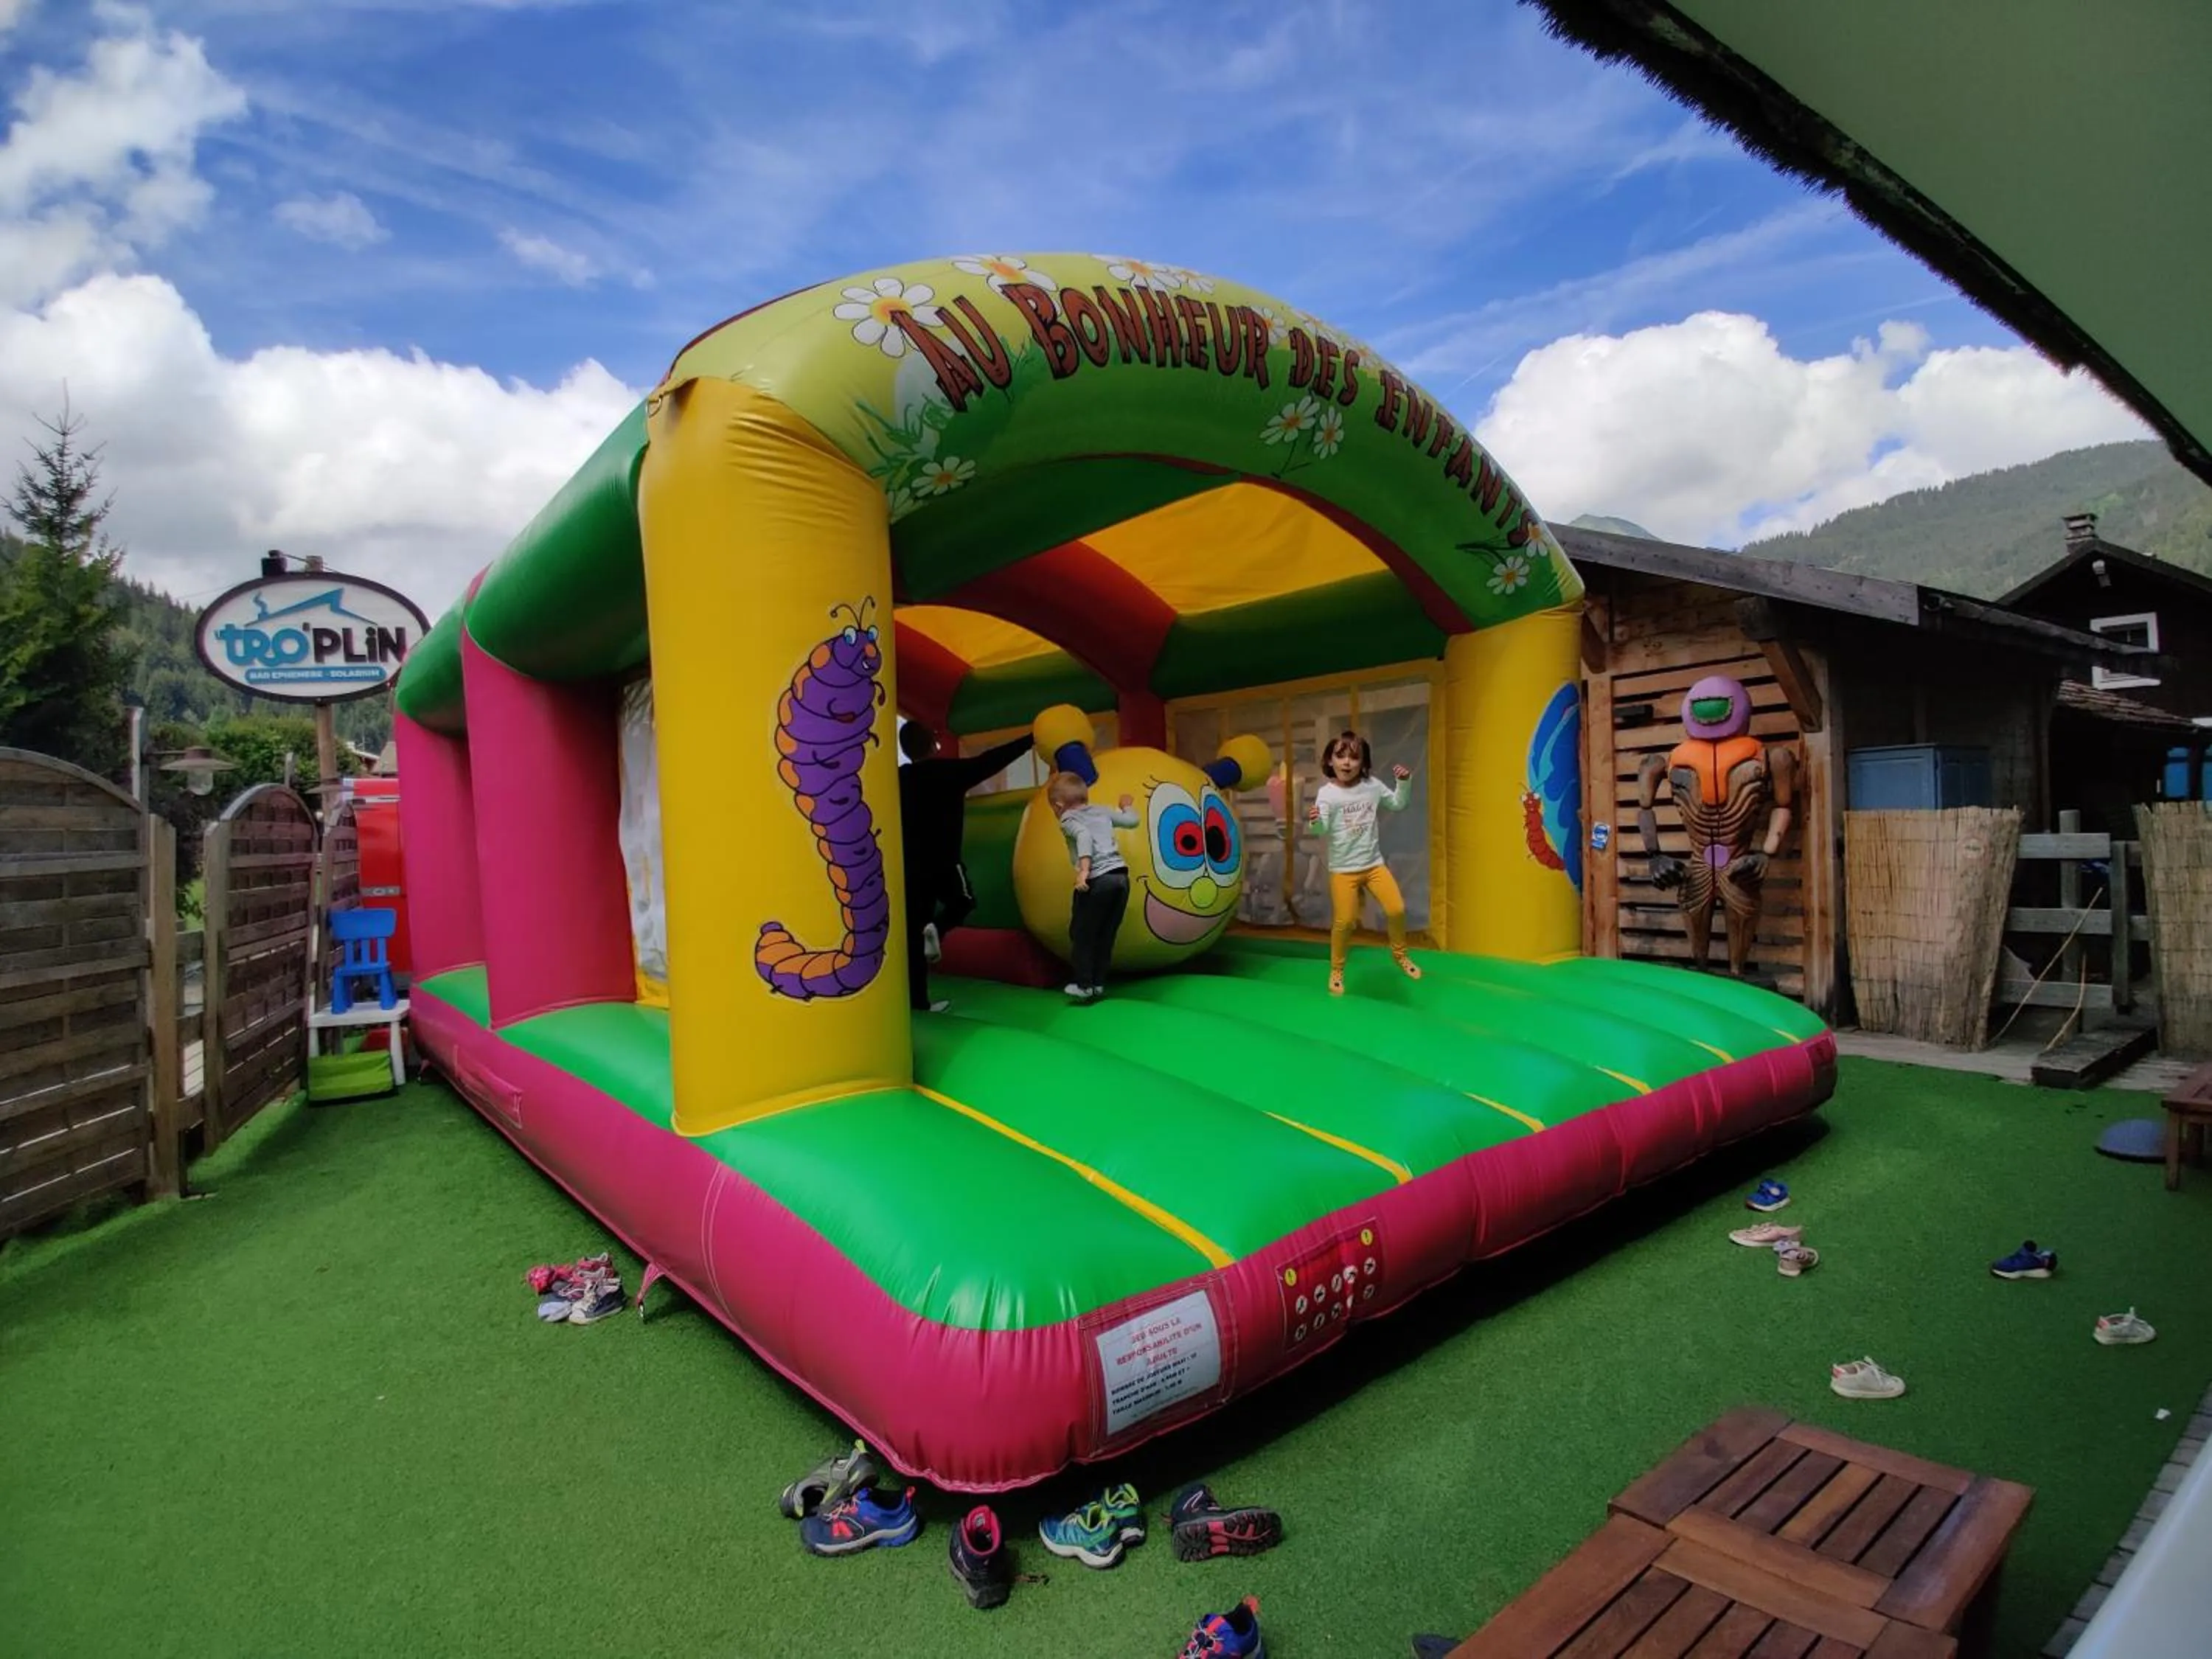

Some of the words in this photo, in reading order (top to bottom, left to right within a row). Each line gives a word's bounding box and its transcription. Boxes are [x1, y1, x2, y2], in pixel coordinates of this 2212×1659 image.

[891, 295, 1012, 413] AU
[1000, 282, 1270, 391] BONHEUR
[1287, 327, 1360, 406] DES
[1374, 369, 1543, 547] ENFANTS
[1148, 1321, 1169, 1335] SOUS
